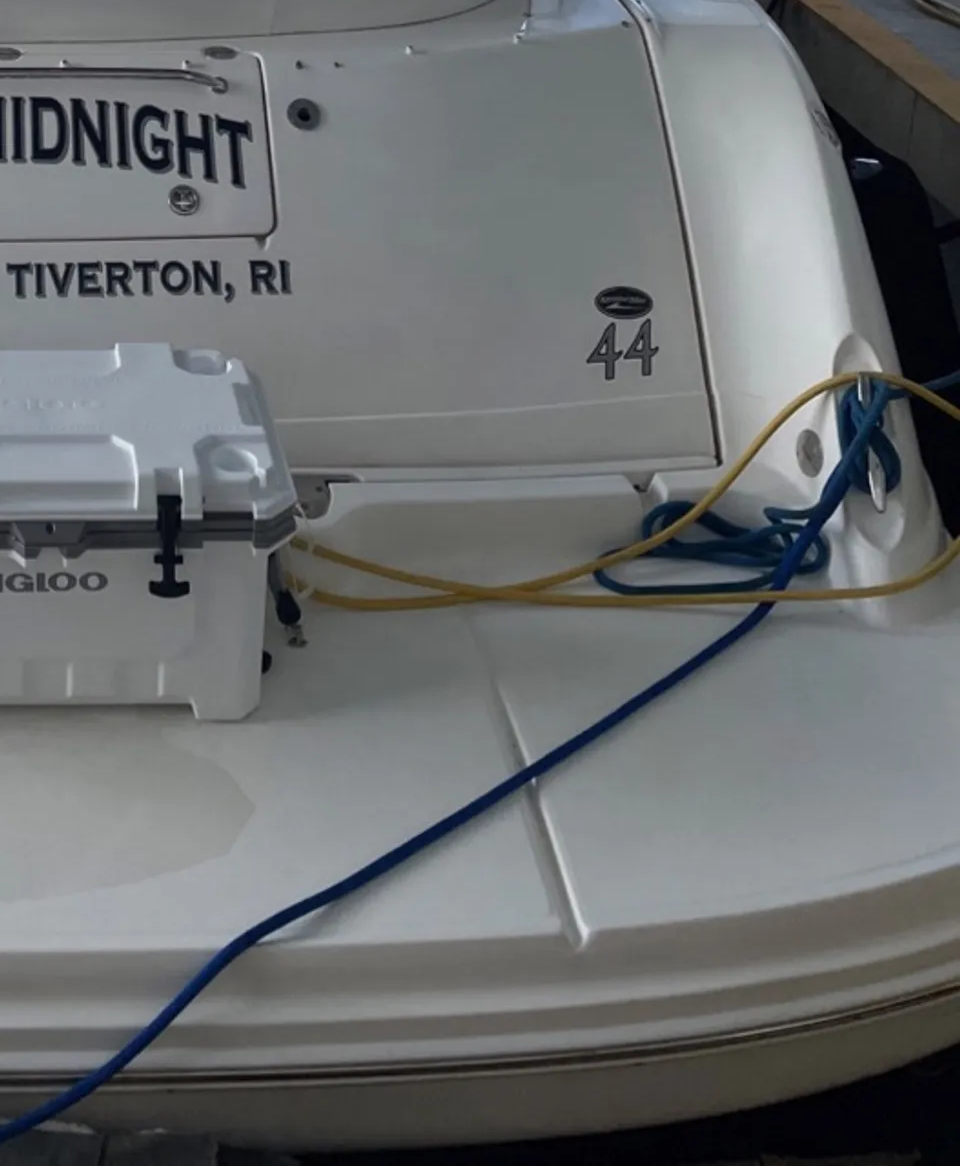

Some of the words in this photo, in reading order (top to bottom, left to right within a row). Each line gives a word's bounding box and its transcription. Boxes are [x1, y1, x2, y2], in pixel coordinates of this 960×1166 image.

[6, 260, 236, 303] TIVERTON,
[248, 259, 292, 296] RI
[586, 318, 659, 381] 44
